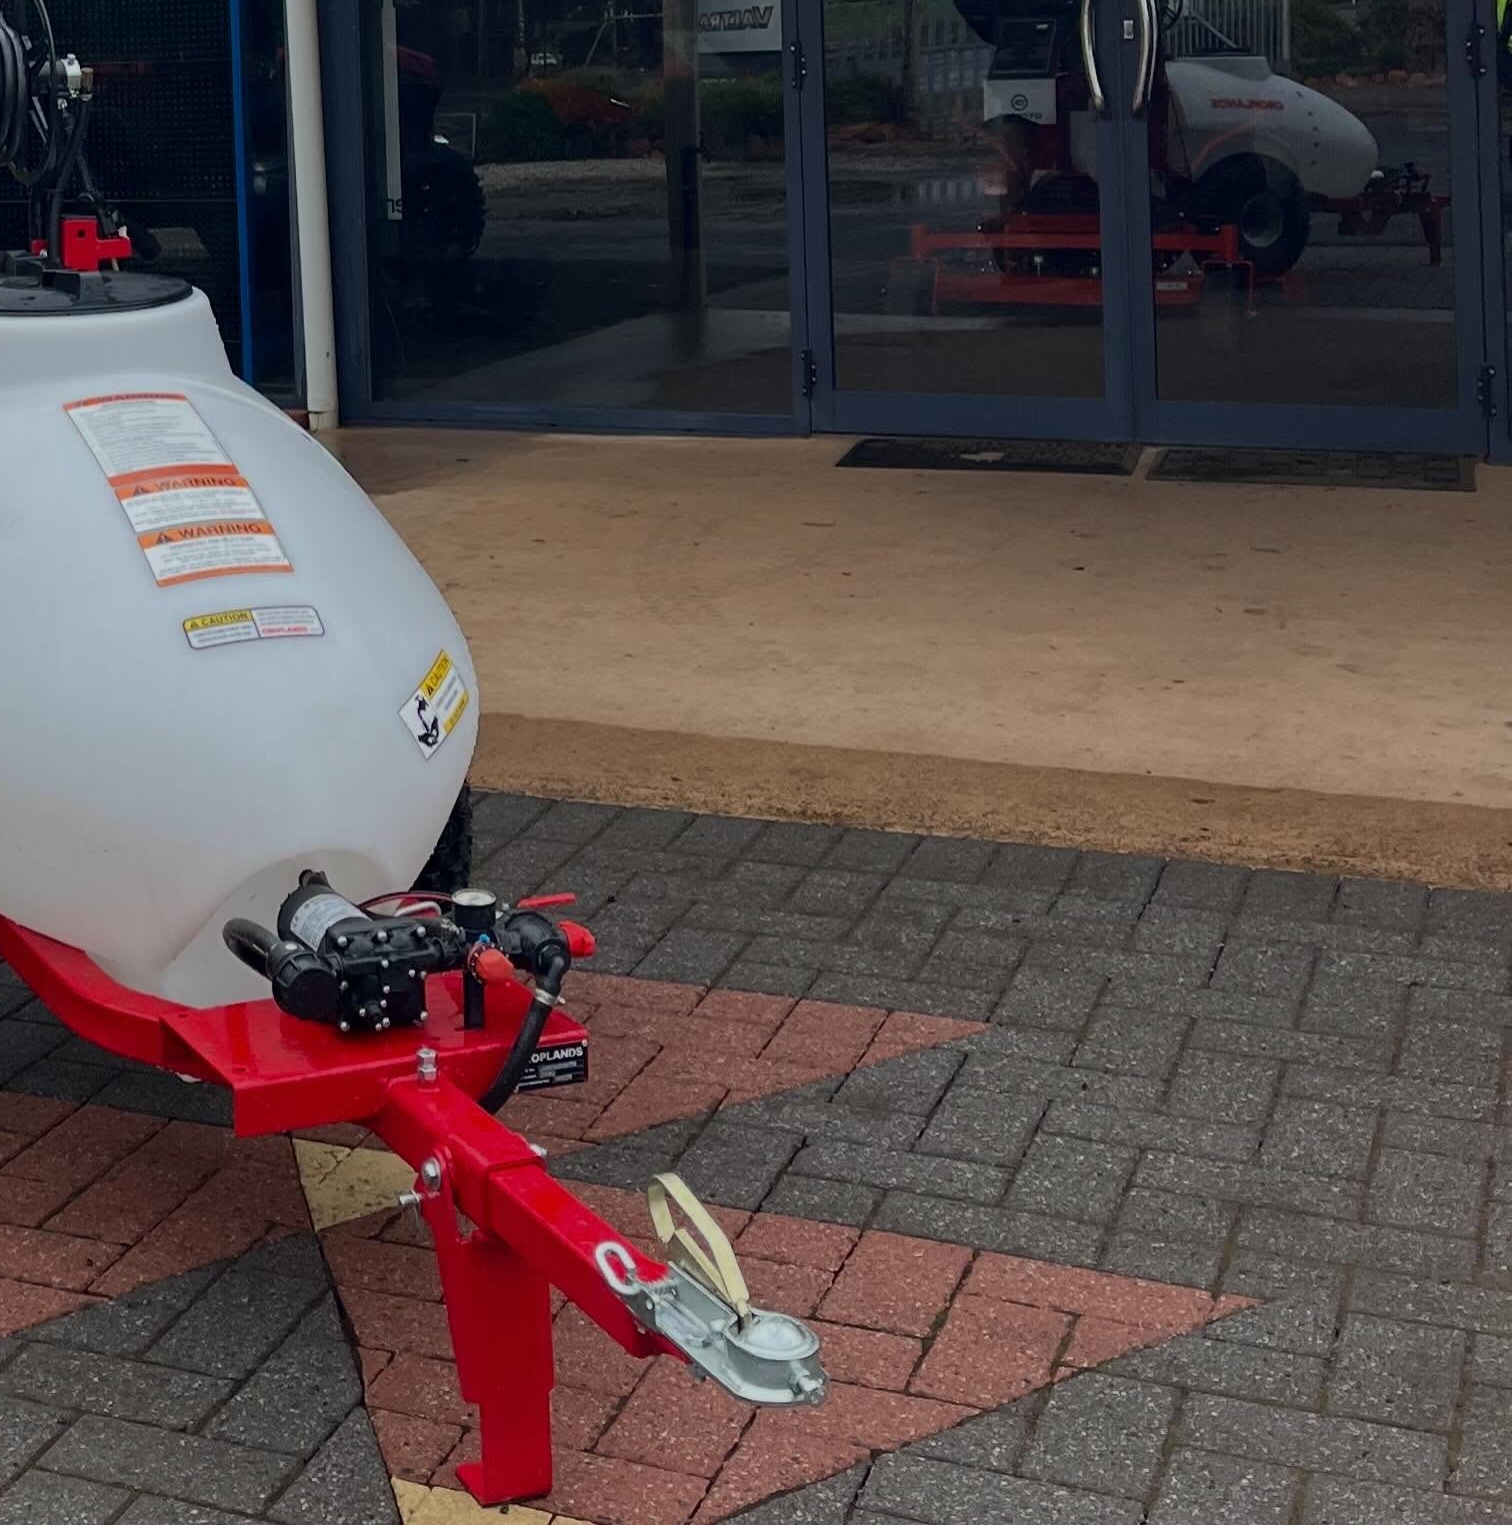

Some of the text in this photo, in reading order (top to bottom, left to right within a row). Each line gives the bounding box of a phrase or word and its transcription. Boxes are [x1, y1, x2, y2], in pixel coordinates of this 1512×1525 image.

[154, 477, 237, 492] WARNING
[178, 523, 261, 540] WARNING
[201, 612, 248, 627] CAUTION
[529, 1046, 584, 1063] OPLANDS
